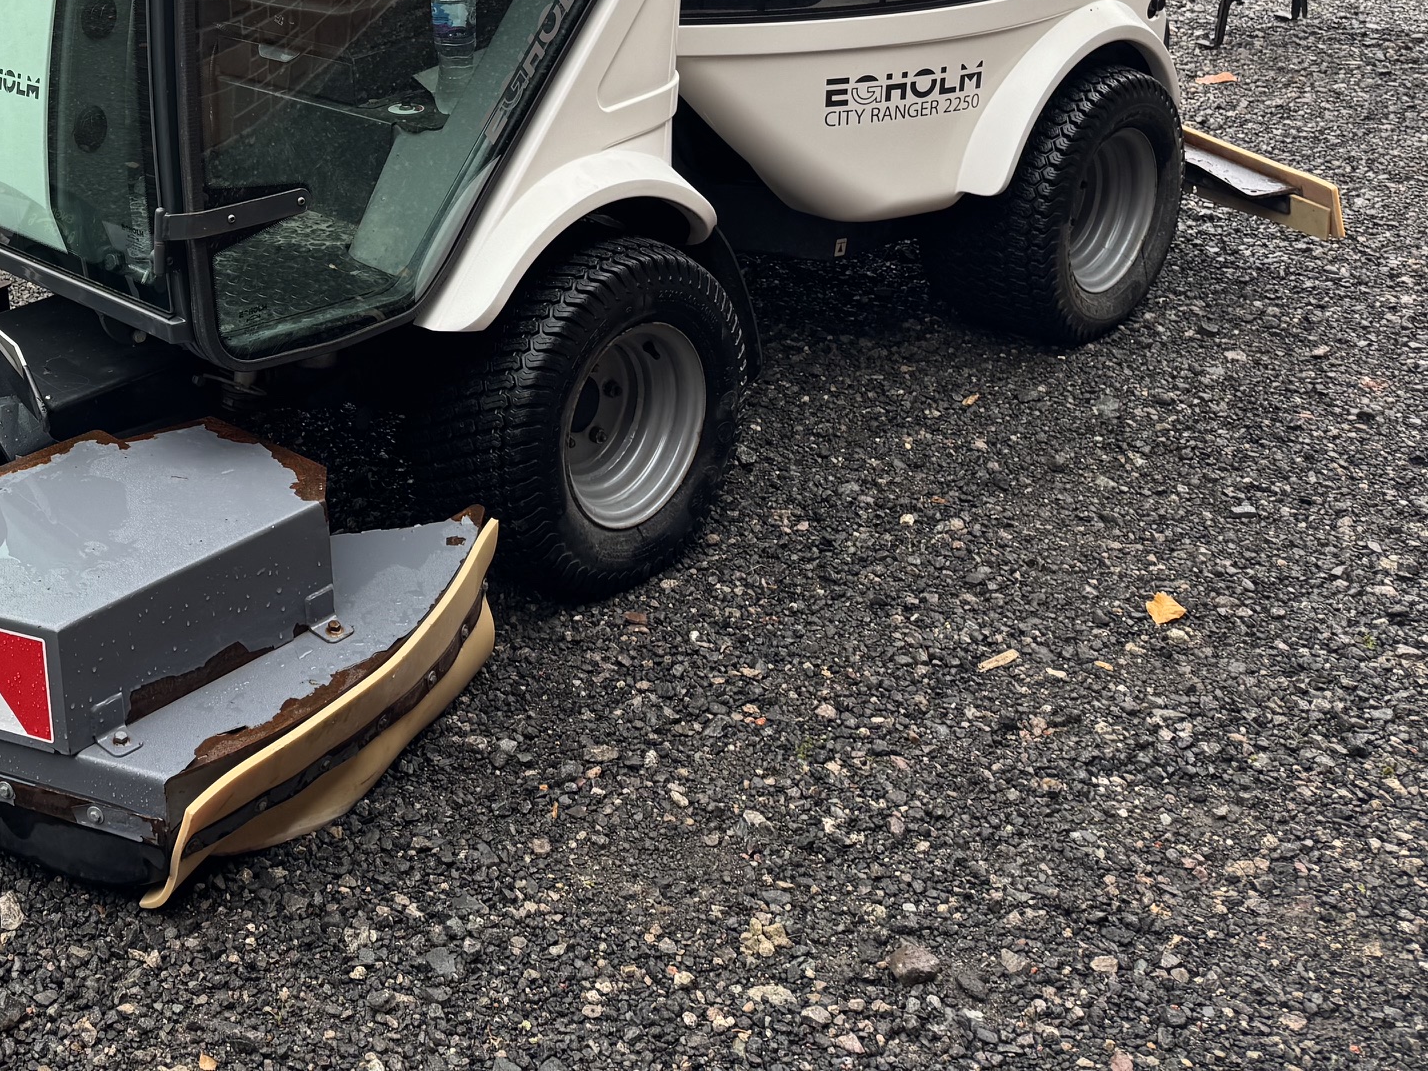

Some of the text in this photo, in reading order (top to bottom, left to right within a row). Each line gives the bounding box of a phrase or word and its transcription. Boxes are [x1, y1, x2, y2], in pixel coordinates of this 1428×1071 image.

[825, 60, 984, 107] EGHOLM
[824, 93, 980, 127] CITY RANGER 2250
